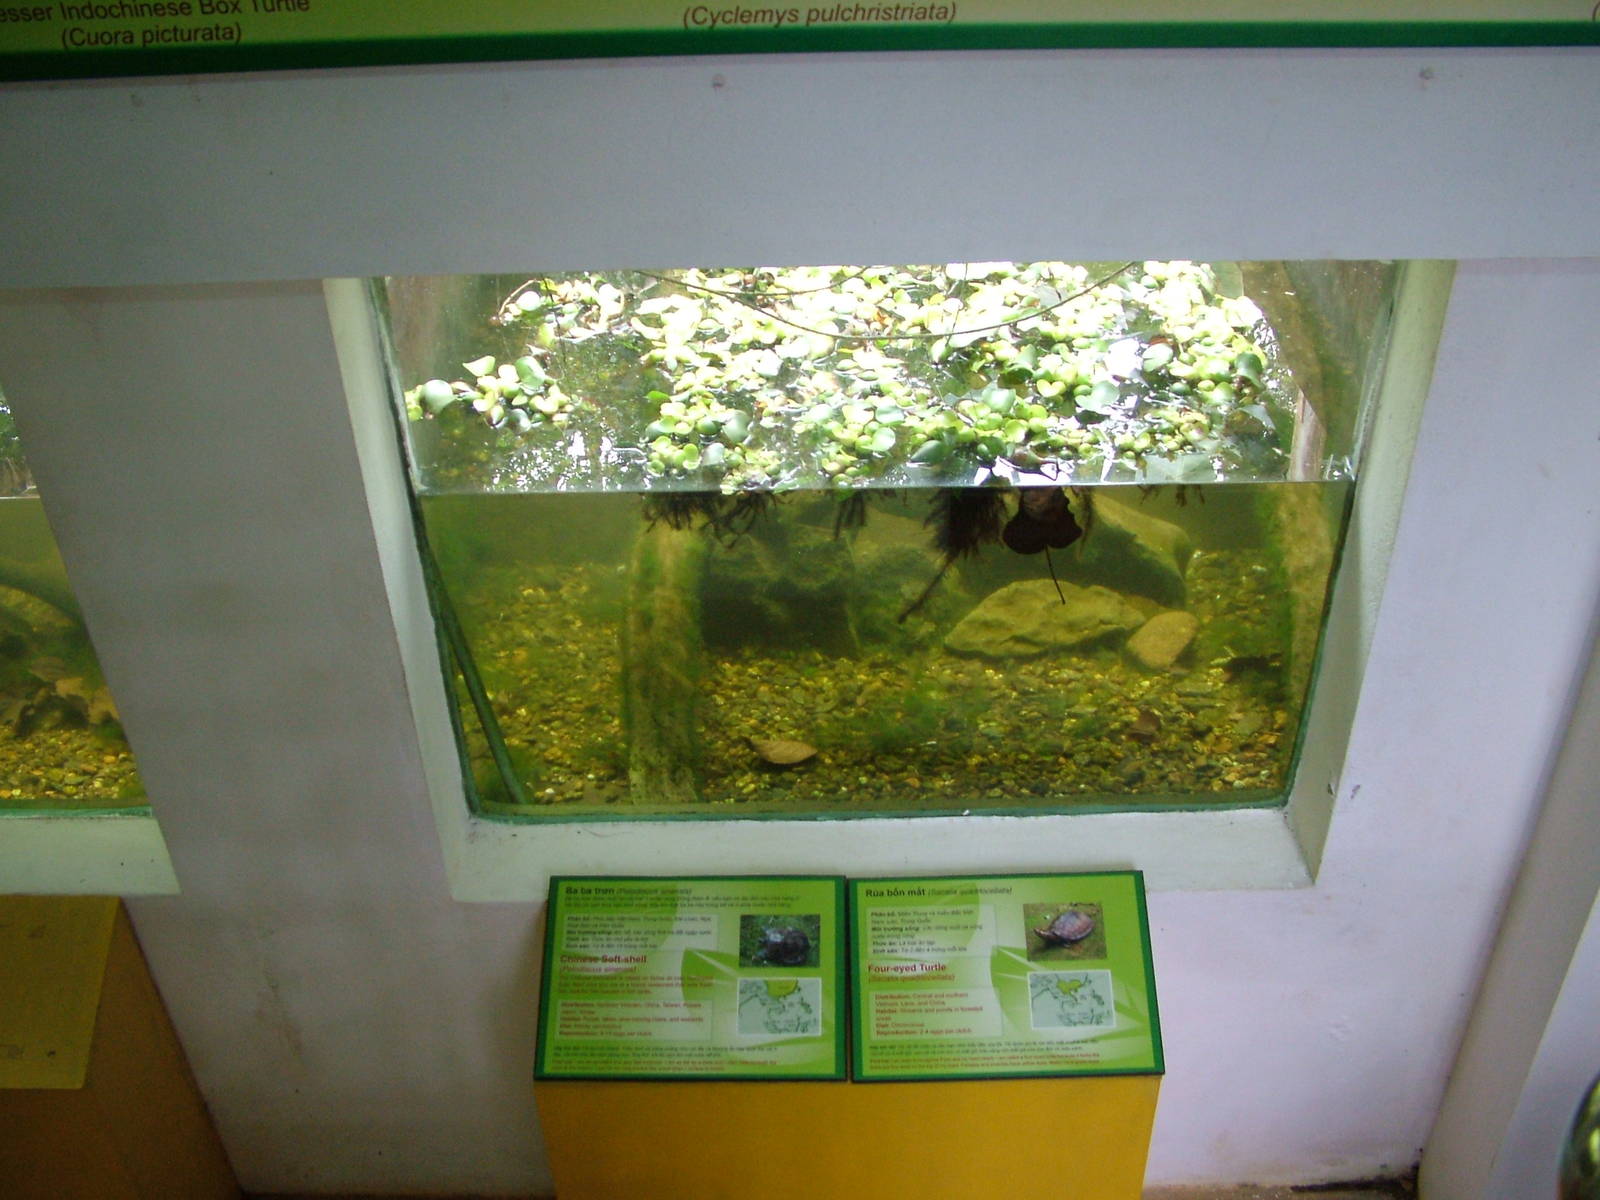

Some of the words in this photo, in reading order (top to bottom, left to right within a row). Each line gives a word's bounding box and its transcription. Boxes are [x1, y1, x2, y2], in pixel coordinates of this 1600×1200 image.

[682, 5, 800, 28] (Cyclemys
[805, 1, 957, 26] pulchristriata)
[62, 26, 135, 50] (Cuora
[142, 21, 242, 47] picturata)
[868, 963, 917, 975] Four-eyed
[920, 962, 947, 972] Turtle
